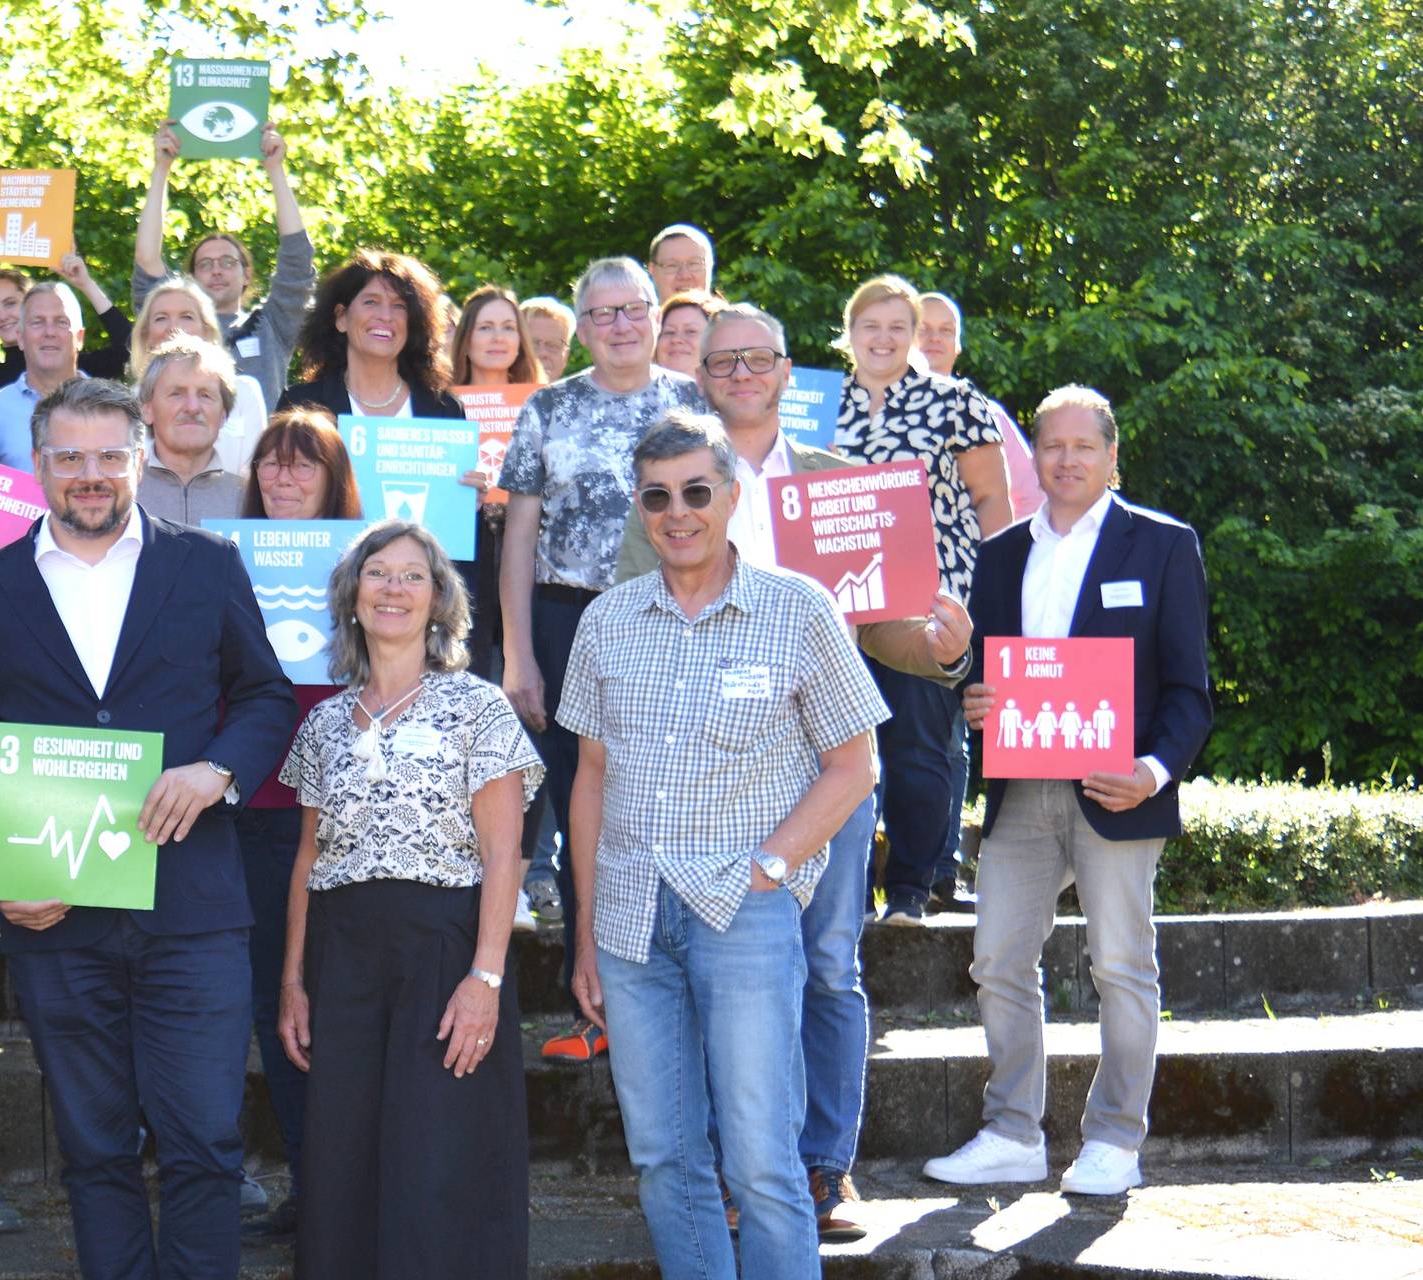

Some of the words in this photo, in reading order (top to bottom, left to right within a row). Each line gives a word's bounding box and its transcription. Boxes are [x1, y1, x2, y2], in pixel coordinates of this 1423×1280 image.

[175, 64, 194, 87] 13
[199, 64, 252, 75] MASSNAHMEN
[252, 66, 269, 77] ZUM
[198, 76, 251, 89] KLIMASCHUTZ
[1, 175, 52, 186] NACHHALTIGE
[28, 186, 44, 197] UND
[350, 425, 367, 456] 6
[377, 427, 431, 442] SAUBERES
[432, 430, 475, 445] WASSER
[377, 445, 398, 458] UND
[377, 460, 457, 477] EINRICHTUNGEN
[781, 485, 801, 520] 8
[811, 499, 850, 517] ARBEIT
[851, 495, 876, 512] UND
[811, 511, 896, 536] WIRTSCHAFTS-
[253, 531, 290, 547] LEBEN
[291, 531, 330, 547] UNTER
[814, 532, 881, 555] WACHSTUM
[253, 552, 304, 567] WASSER
[999, 646, 1010, 678] 1
[1025, 647, 1056, 661] KEINE
[1025, 663, 1064, 678] ARMUT
[0, 735, 20, 775] 3
[33, 736, 113, 759] GESUNDHEIT
[114, 742, 143, 761] UND
[33, 757, 128, 781] WOHLERGEHEN
